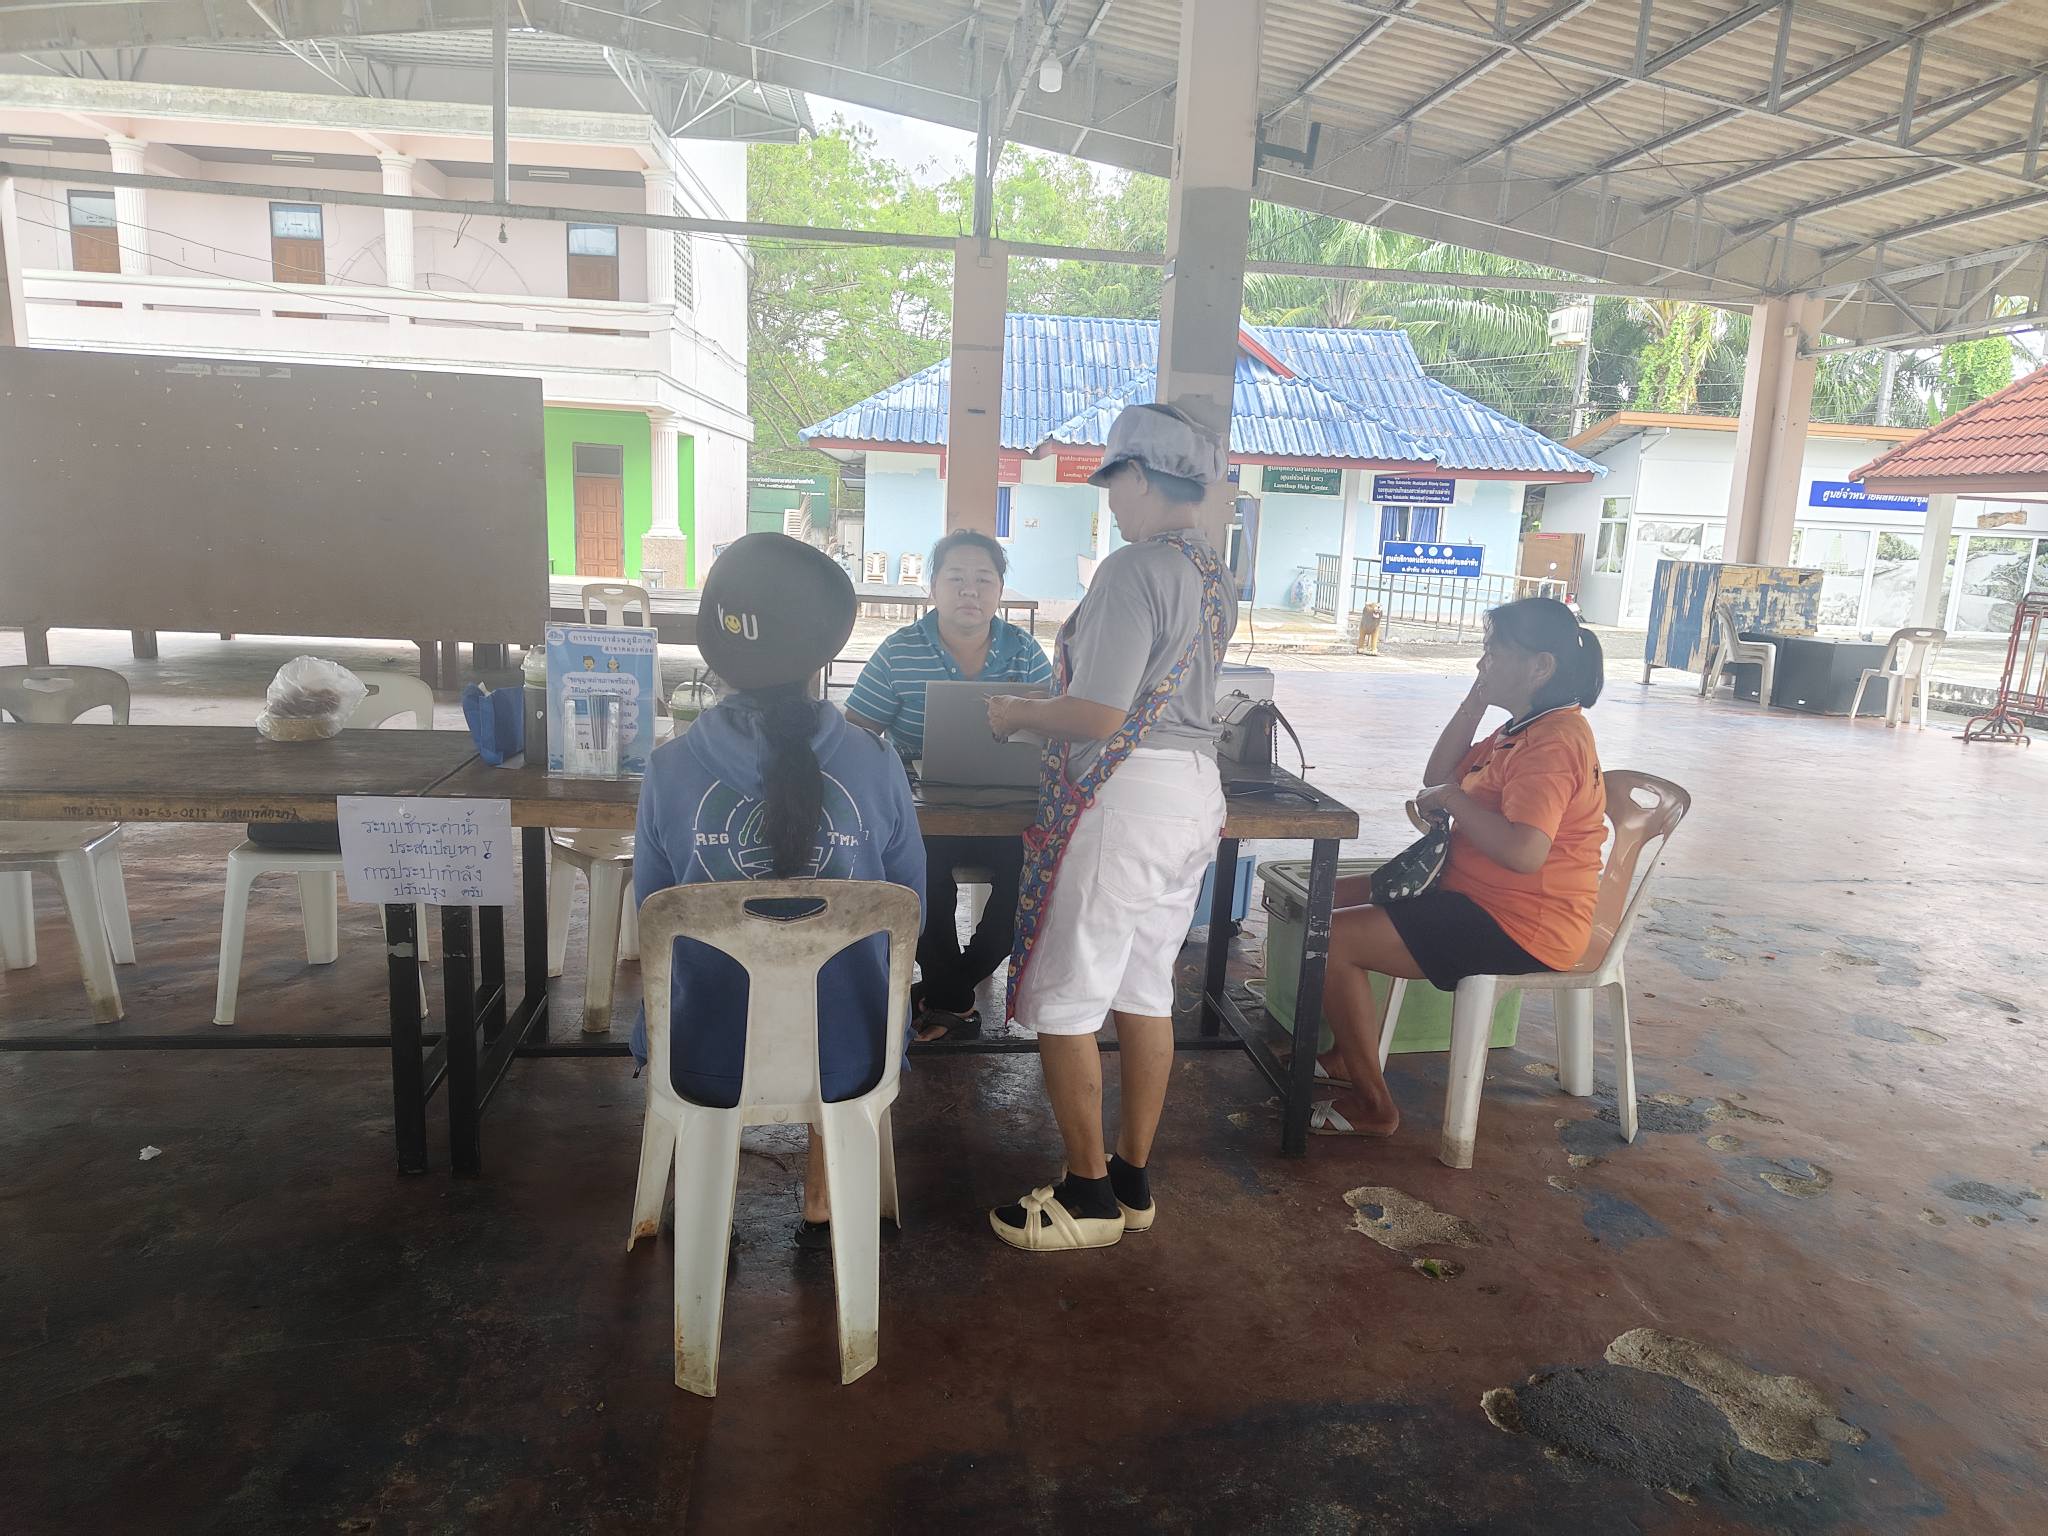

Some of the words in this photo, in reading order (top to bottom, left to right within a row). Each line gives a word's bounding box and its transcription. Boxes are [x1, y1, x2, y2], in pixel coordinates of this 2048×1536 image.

[361, 810, 479, 836] ระบบชำระค่าน้ำ
[389, 838, 477, 859] ประสบปัญหา
[695, 832, 730, 846] REG
[363, 860, 483, 882] การประปากำลัง
[394, 882, 447, 902] ปรับปรุง
[461, 886, 484, 898] ครับ
